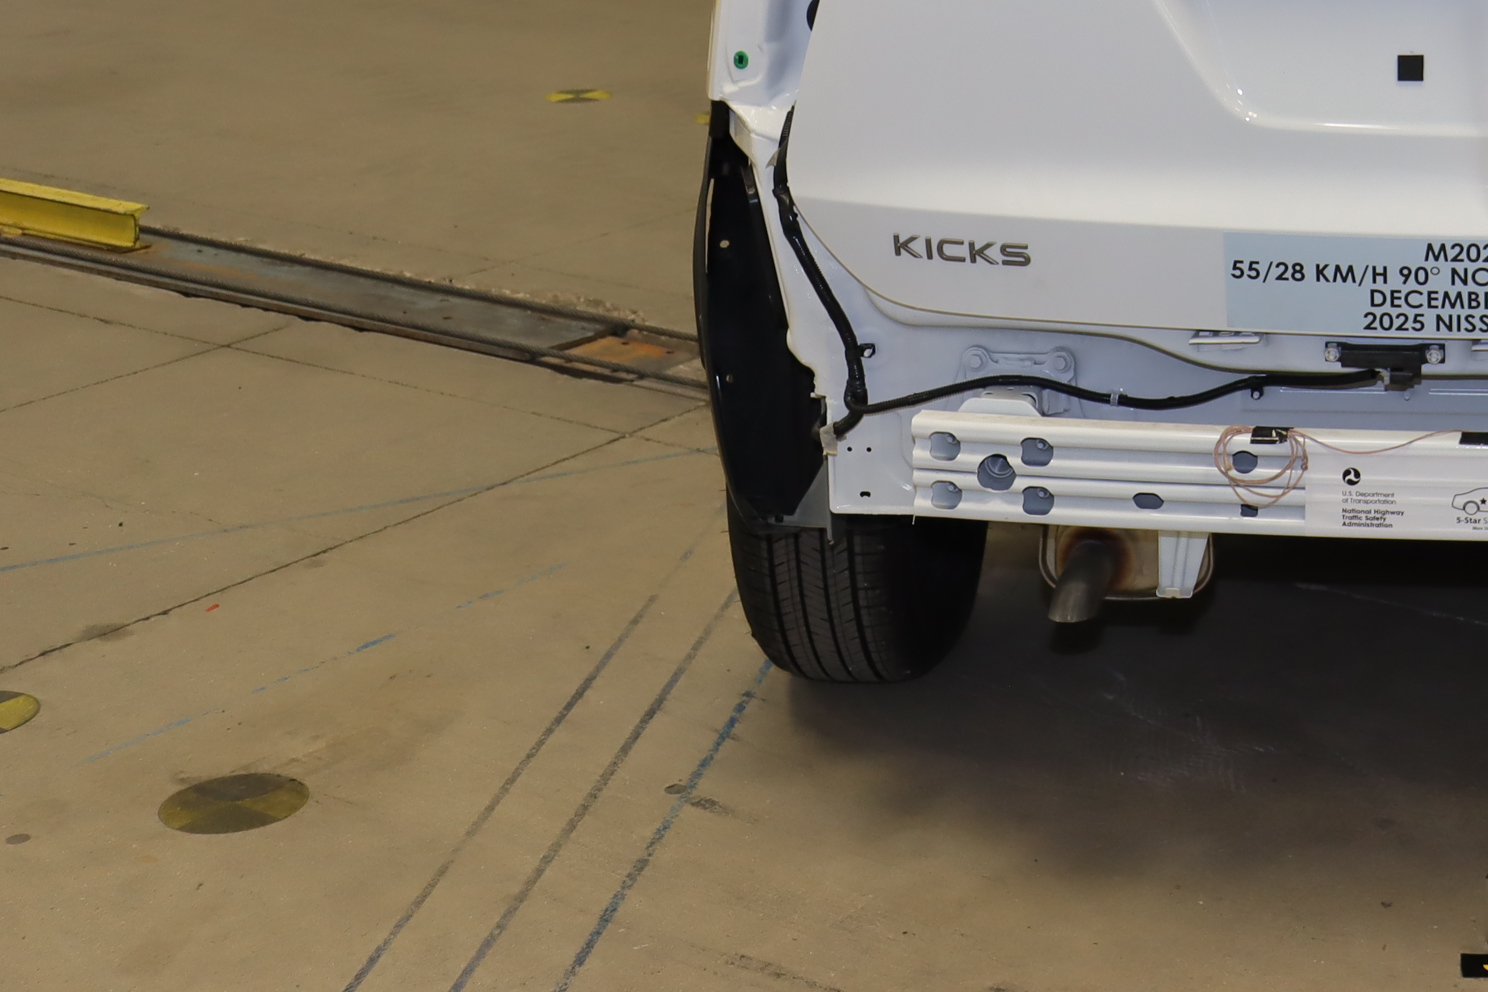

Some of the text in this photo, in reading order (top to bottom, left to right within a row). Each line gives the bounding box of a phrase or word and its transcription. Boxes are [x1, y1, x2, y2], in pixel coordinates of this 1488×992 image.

[893, 233, 1031, 266] KICKS
[1231, 260, 1305, 283] 55/28
[1316, 264, 1387, 286] KM/H
[1399, 266, 1440, 285] 90°
[1363, 312, 1424, 331] 2025
